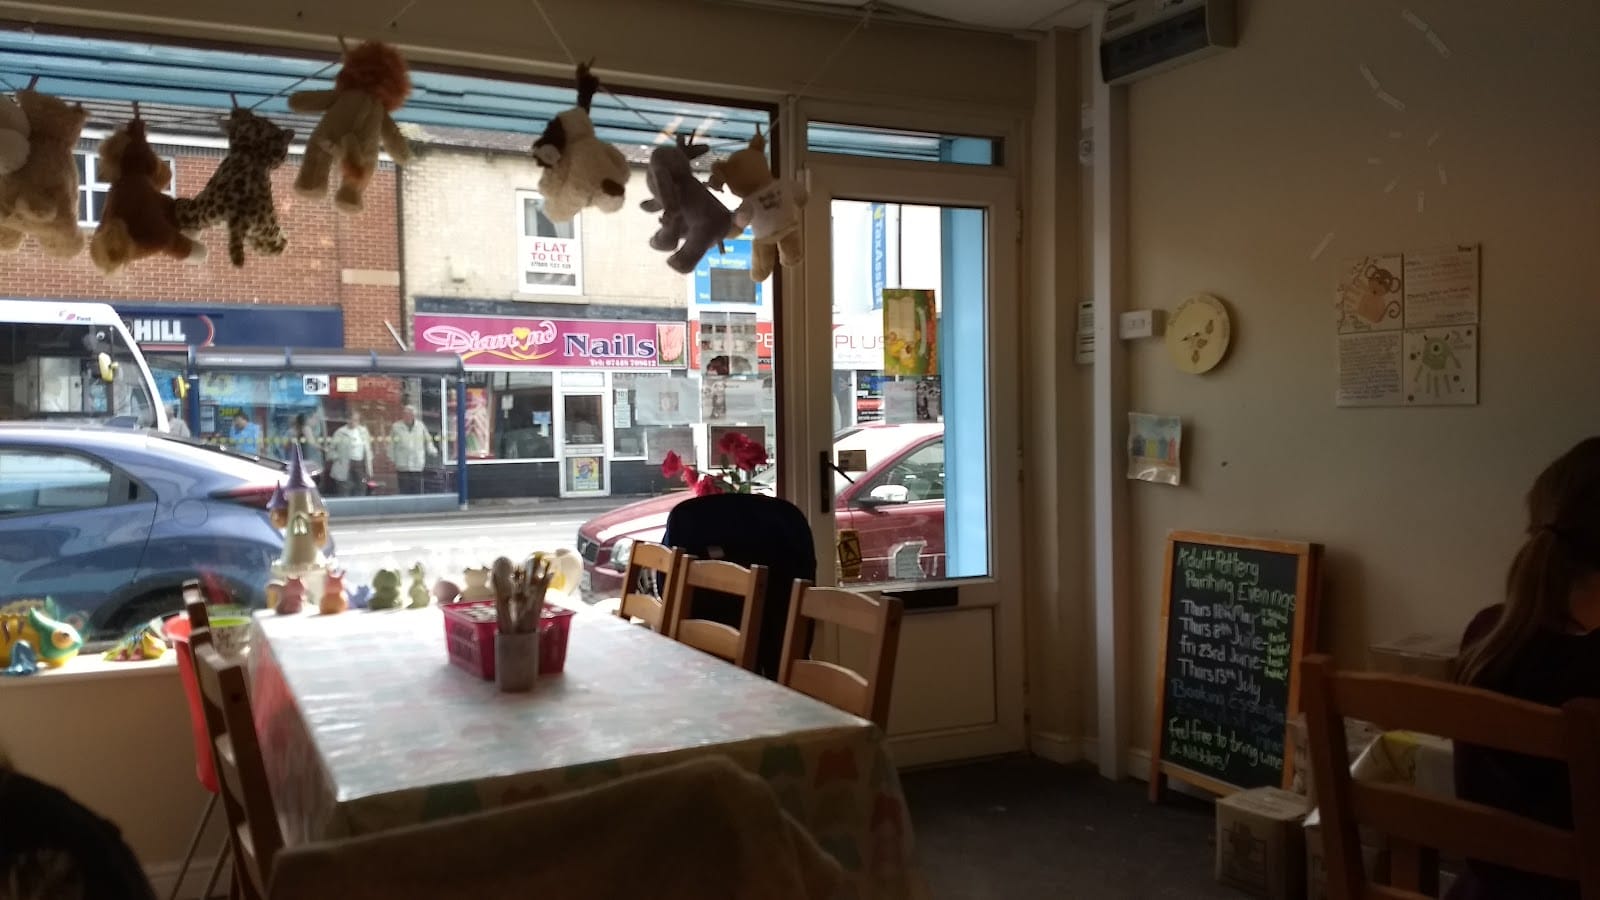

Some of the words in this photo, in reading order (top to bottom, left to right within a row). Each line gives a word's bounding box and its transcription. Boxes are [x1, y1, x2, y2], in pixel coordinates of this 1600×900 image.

[530, 252, 546, 261] TO
[550, 253, 571, 263] LET
[534, 241, 567, 253] FLAT
[134, 319, 186, 342] HILL
[422, 319, 558, 355] Diamond
[562, 332, 657, 358] Nails
[1177, 547, 1215, 570] Adult
[1215, 550, 1260, 586] Pottery
[1179, 598, 1212, 617] Thurs
[1184, 569, 1236, 608] Painting
[1237, 582, 1297, 622] Evenings
[1178, 616, 1212, 638] Thurs
[1178, 634, 1197, 656] Fri
[1197, 642, 1226, 662] 23rd
[1176, 657, 1214, 682] Thurs
[1236, 669, 1262, 705] July
[1168, 716, 1190, 741] Feel
[1190, 718, 1213, 746] free
[1214, 725, 1228, 749] to
[1230, 730, 1260, 768] bring
